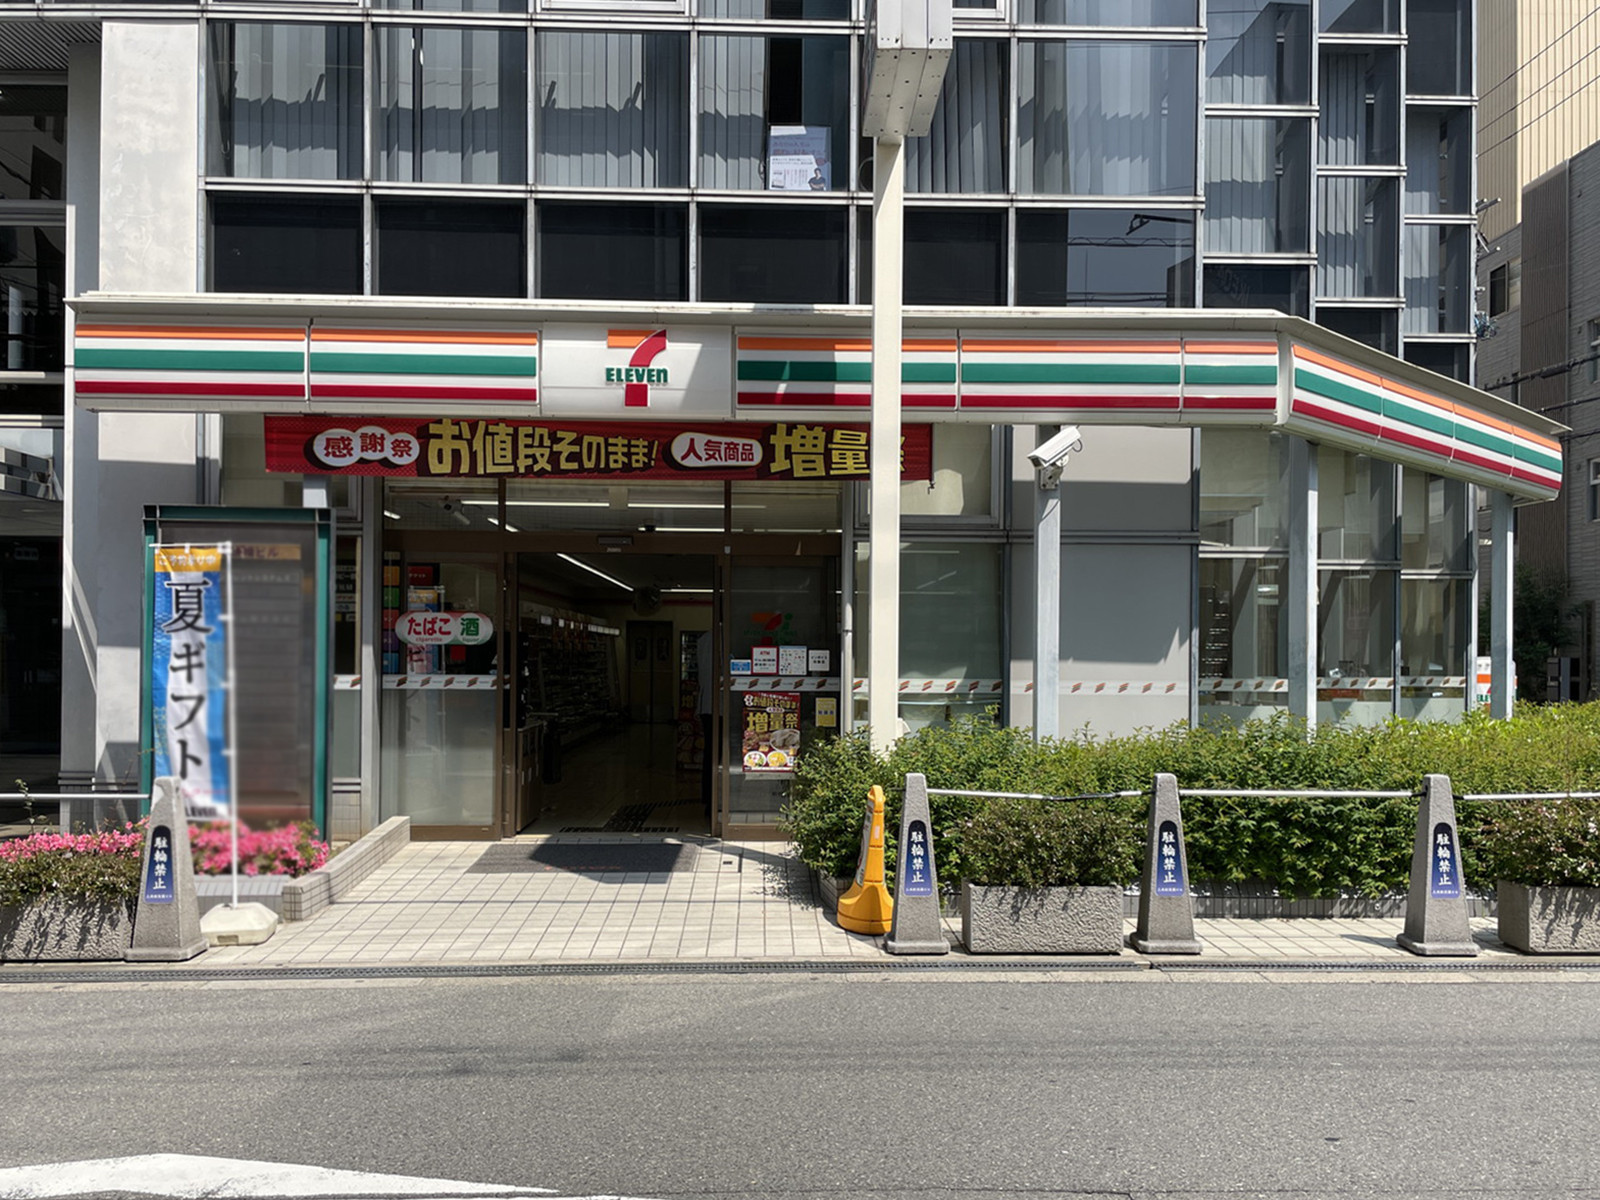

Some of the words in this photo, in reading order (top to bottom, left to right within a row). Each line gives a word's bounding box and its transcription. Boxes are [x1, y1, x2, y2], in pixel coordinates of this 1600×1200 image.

[324, 432, 413, 458] 感謝祭
[428, 418, 658, 475] お値段そのまま!
[680, 437, 755, 462] 人気商品
[770, 422, 905, 477] 増量
[407, 617, 451, 636] たばこ
[460, 617, 480, 636] 酒
[162, 578, 212, 780] 夏ギフト
[747, 712, 798, 732] 増量祭
[153, 836, 168, 889] 駐輪禁止
[910, 831, 925, 883] 駐輪禁止
[1161, 831, 1176, 883] 駐輪禁止
[1436, 833, 1452, 886] 駐輪禁止
